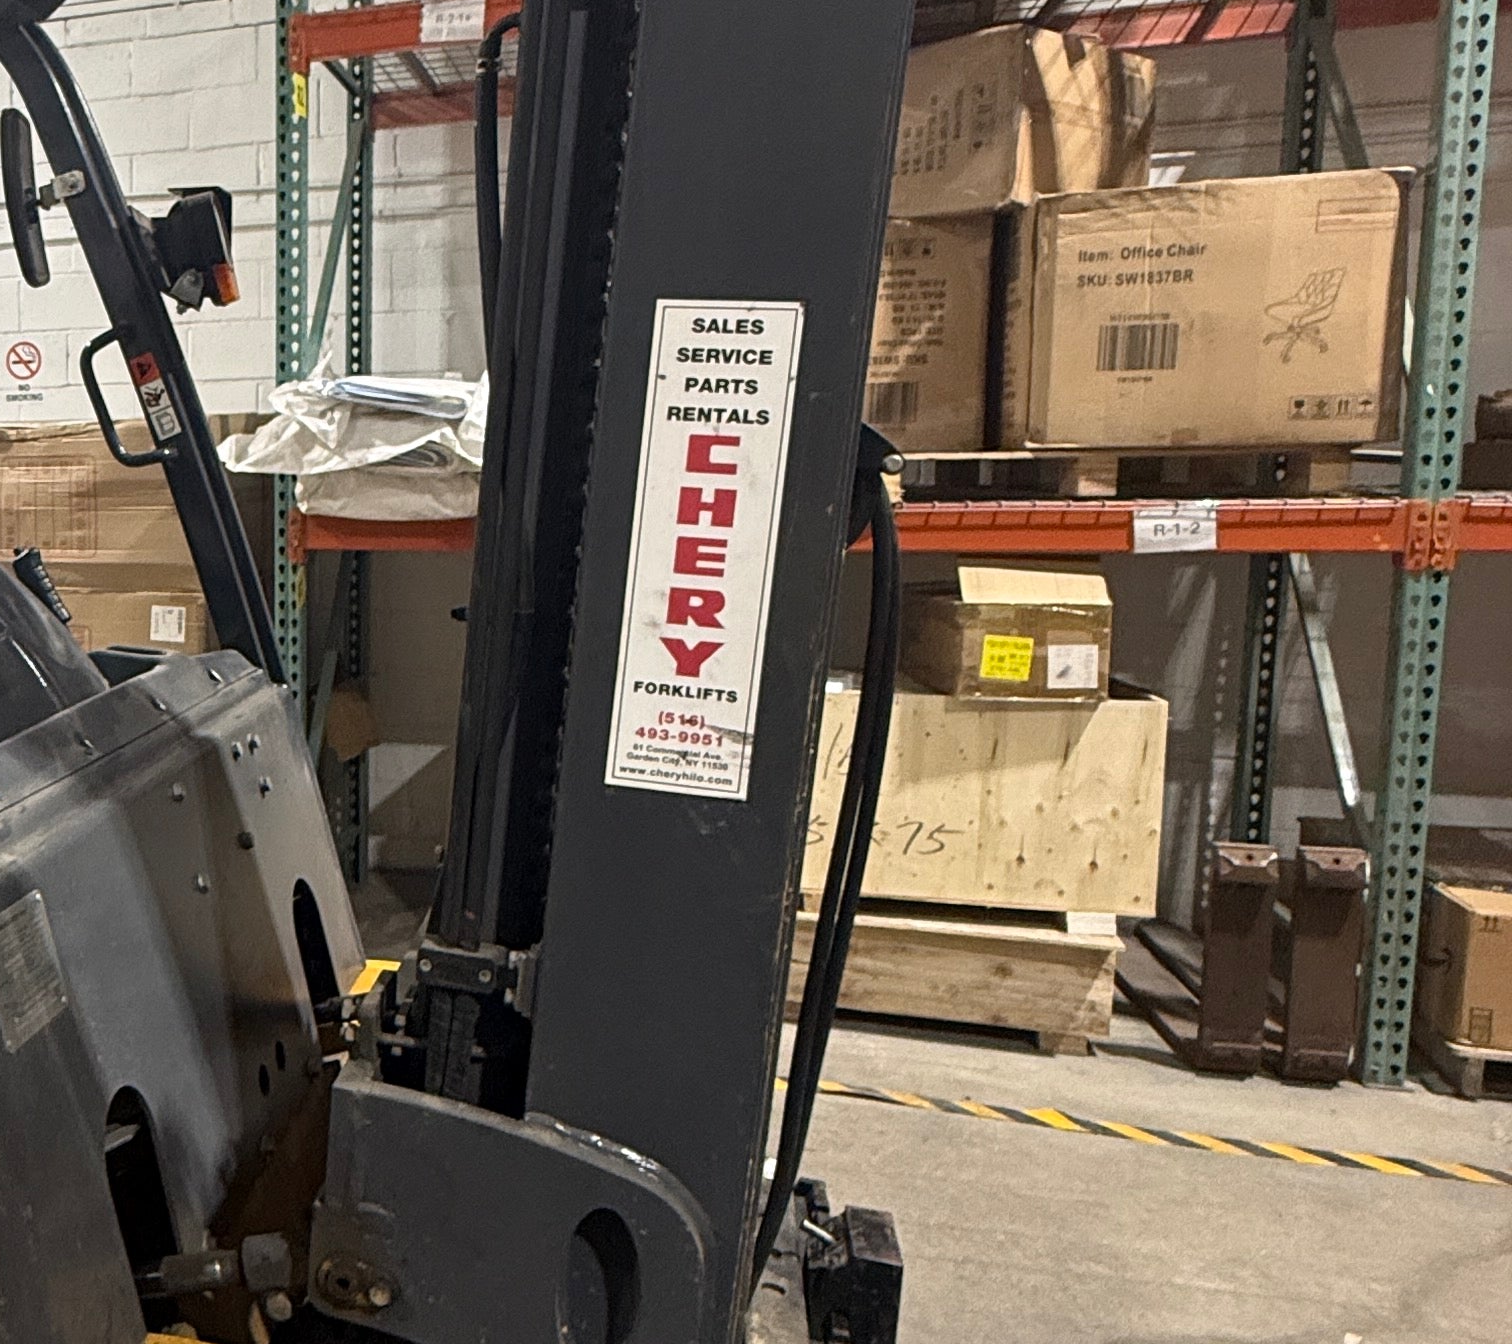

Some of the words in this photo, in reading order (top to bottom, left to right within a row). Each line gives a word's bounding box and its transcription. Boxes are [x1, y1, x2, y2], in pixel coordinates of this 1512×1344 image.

[1078, 249, 1113, 263] Item:
[1120, 246, 1164, 261] Office
[1166, 243, 1208, 257] Chair
[1076, 274, 1112, 288] SKU:
[691, 317, 765, 335] SALES
[676, 347, 774, 366] SERVICE
[684, 377, 759, 395] PARTS
[6, 393, 43, 402] SMOKING
[666, 405, 770, 425] RENTALS
[1153, 521, 1201, 537] R-1-2
[659, 433, 742, 678] CHERY
[633, 680, 738, 703] FORKLIFTS
[658, 710, 706, 730] (516)
[635, 726, 724, 748] 493-9951
[626, 751, 660, 764] Garden
[619, 765, 733, 786] www.cheryhilo.com
